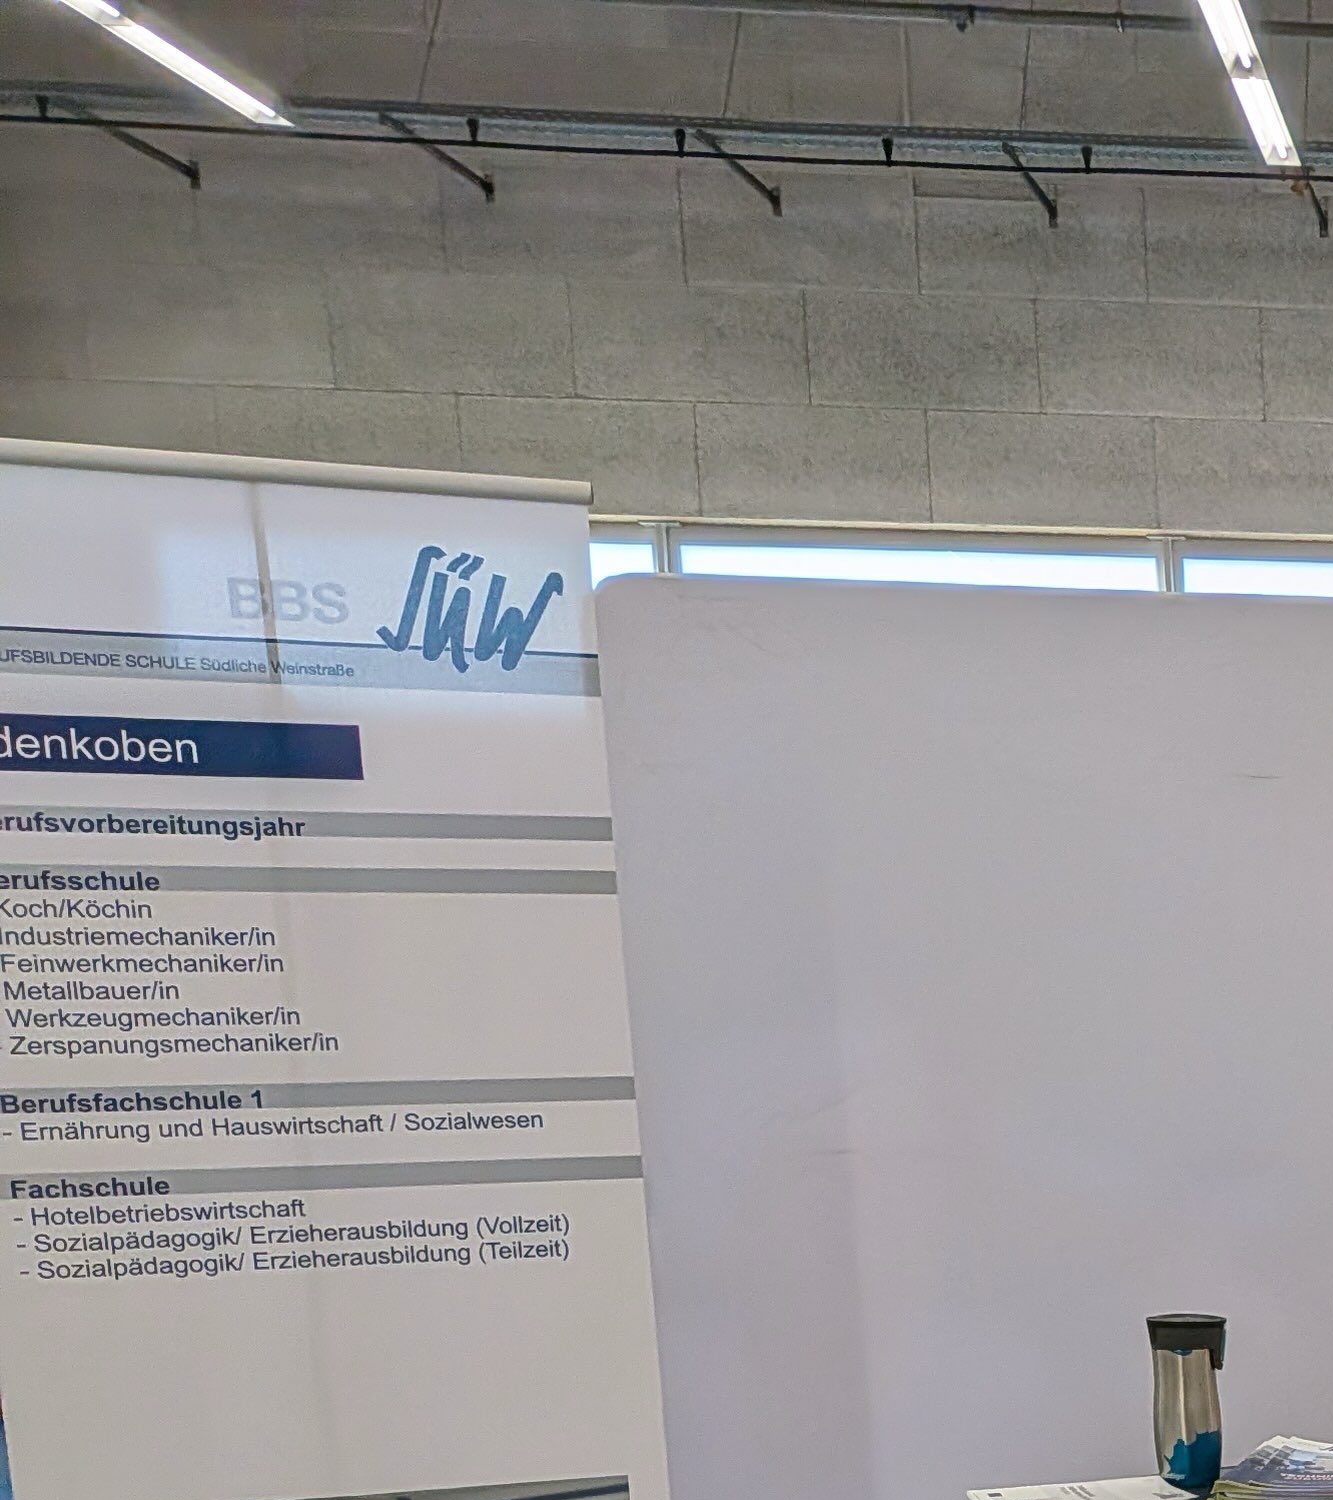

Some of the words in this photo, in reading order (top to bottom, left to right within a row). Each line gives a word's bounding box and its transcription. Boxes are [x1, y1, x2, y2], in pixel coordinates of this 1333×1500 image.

[227, 577, 350, 624] BBS
[126, 654, 196, 671] SCHULE
[200, 658, 266, 675] Südliche
[271, 661, 355, 677] Weinstraße
[0, 811, 305, 841] rufsvorbereitungsjahr
[0, 926, 275, 947] Industriemechaniker/in
[0, 953, 284, 974] Feinwerkmechaniker/in
[4, 981, 179, 1000] Metallbauer/in
[5, 1007, 300, 1031] Werkzeugmechaniker/in
[10, 1033, 338, 1058] Zerspanungsmechaniker/in
[0, 1091, 242, 1114] Berufsfachschule
[250, 1091, 264, 1110] 1
[21, 1121, 150, 1142] Ernährung
[159, 1119, 203, 1137] und
[212, 1114, 383, 1136] Hauswirtschaft
[405, 1112, 543, 1131] Sozialwesen
[11, 1176, 170, 1200] Fachschule
[31, 1199, 306, 1228] Hotelbetriebswirtschaft
[35, 1227, 244, 1261] Sozialpädagogik/
[250, 1220, 468, 1252] Erzieherausbildung
[477, 1214, 569, 1239] (Vollzeit)
[38, 1253, 244, 1280] Sozialpädagogik/
[253, 1245, 470, 1269] Erzieherausbildung
[479, 1239, 568, 1264] (Teilzeit)
